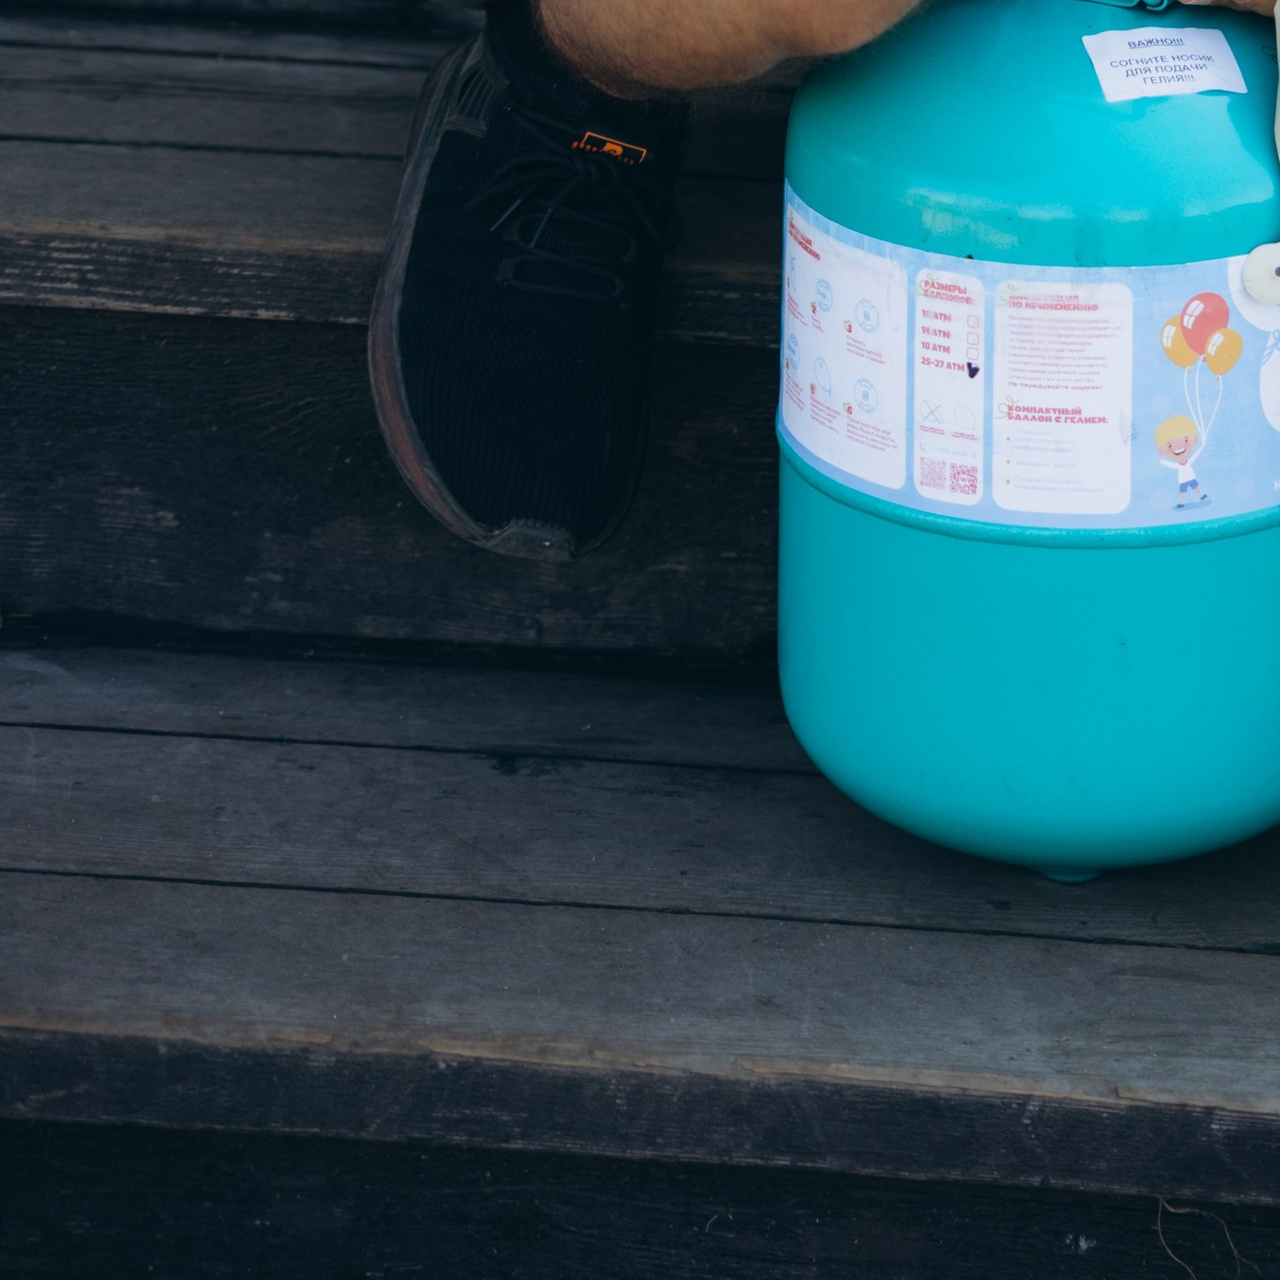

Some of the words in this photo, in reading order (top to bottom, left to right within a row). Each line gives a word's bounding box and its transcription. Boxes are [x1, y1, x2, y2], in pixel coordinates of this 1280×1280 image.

[1128, 37, 1185, 49] ВАЖНО!!!
[1110, 54, 1168, 68] СОГНИТЕ
[1172, 53, 1215, 63] НОСИК
[1125, 67, 1152, 78] ДЛЯ
[1155, 63, 1208, 74] ПОДАЧИ
[1143, 74, 1195, 85] ГЕЛИЯ!!!
[924, 280, 967, 294] РАЗМЕРЫ
[933, 312, 952, 322] АТМ
[932, 328, 950, 339] АТМ
[921, 341, 930, 350] 18
[932, 344, 950, 354] АТМ
[946, 362, 965, 372] АТМ
[1007, 405, 1082, 415] КОМПАКТНЫЙ
[1007, 412, 1052, 423] БАЛЛОН
[1064, 416, 1109, 424] ГЕЛИЕМ:
